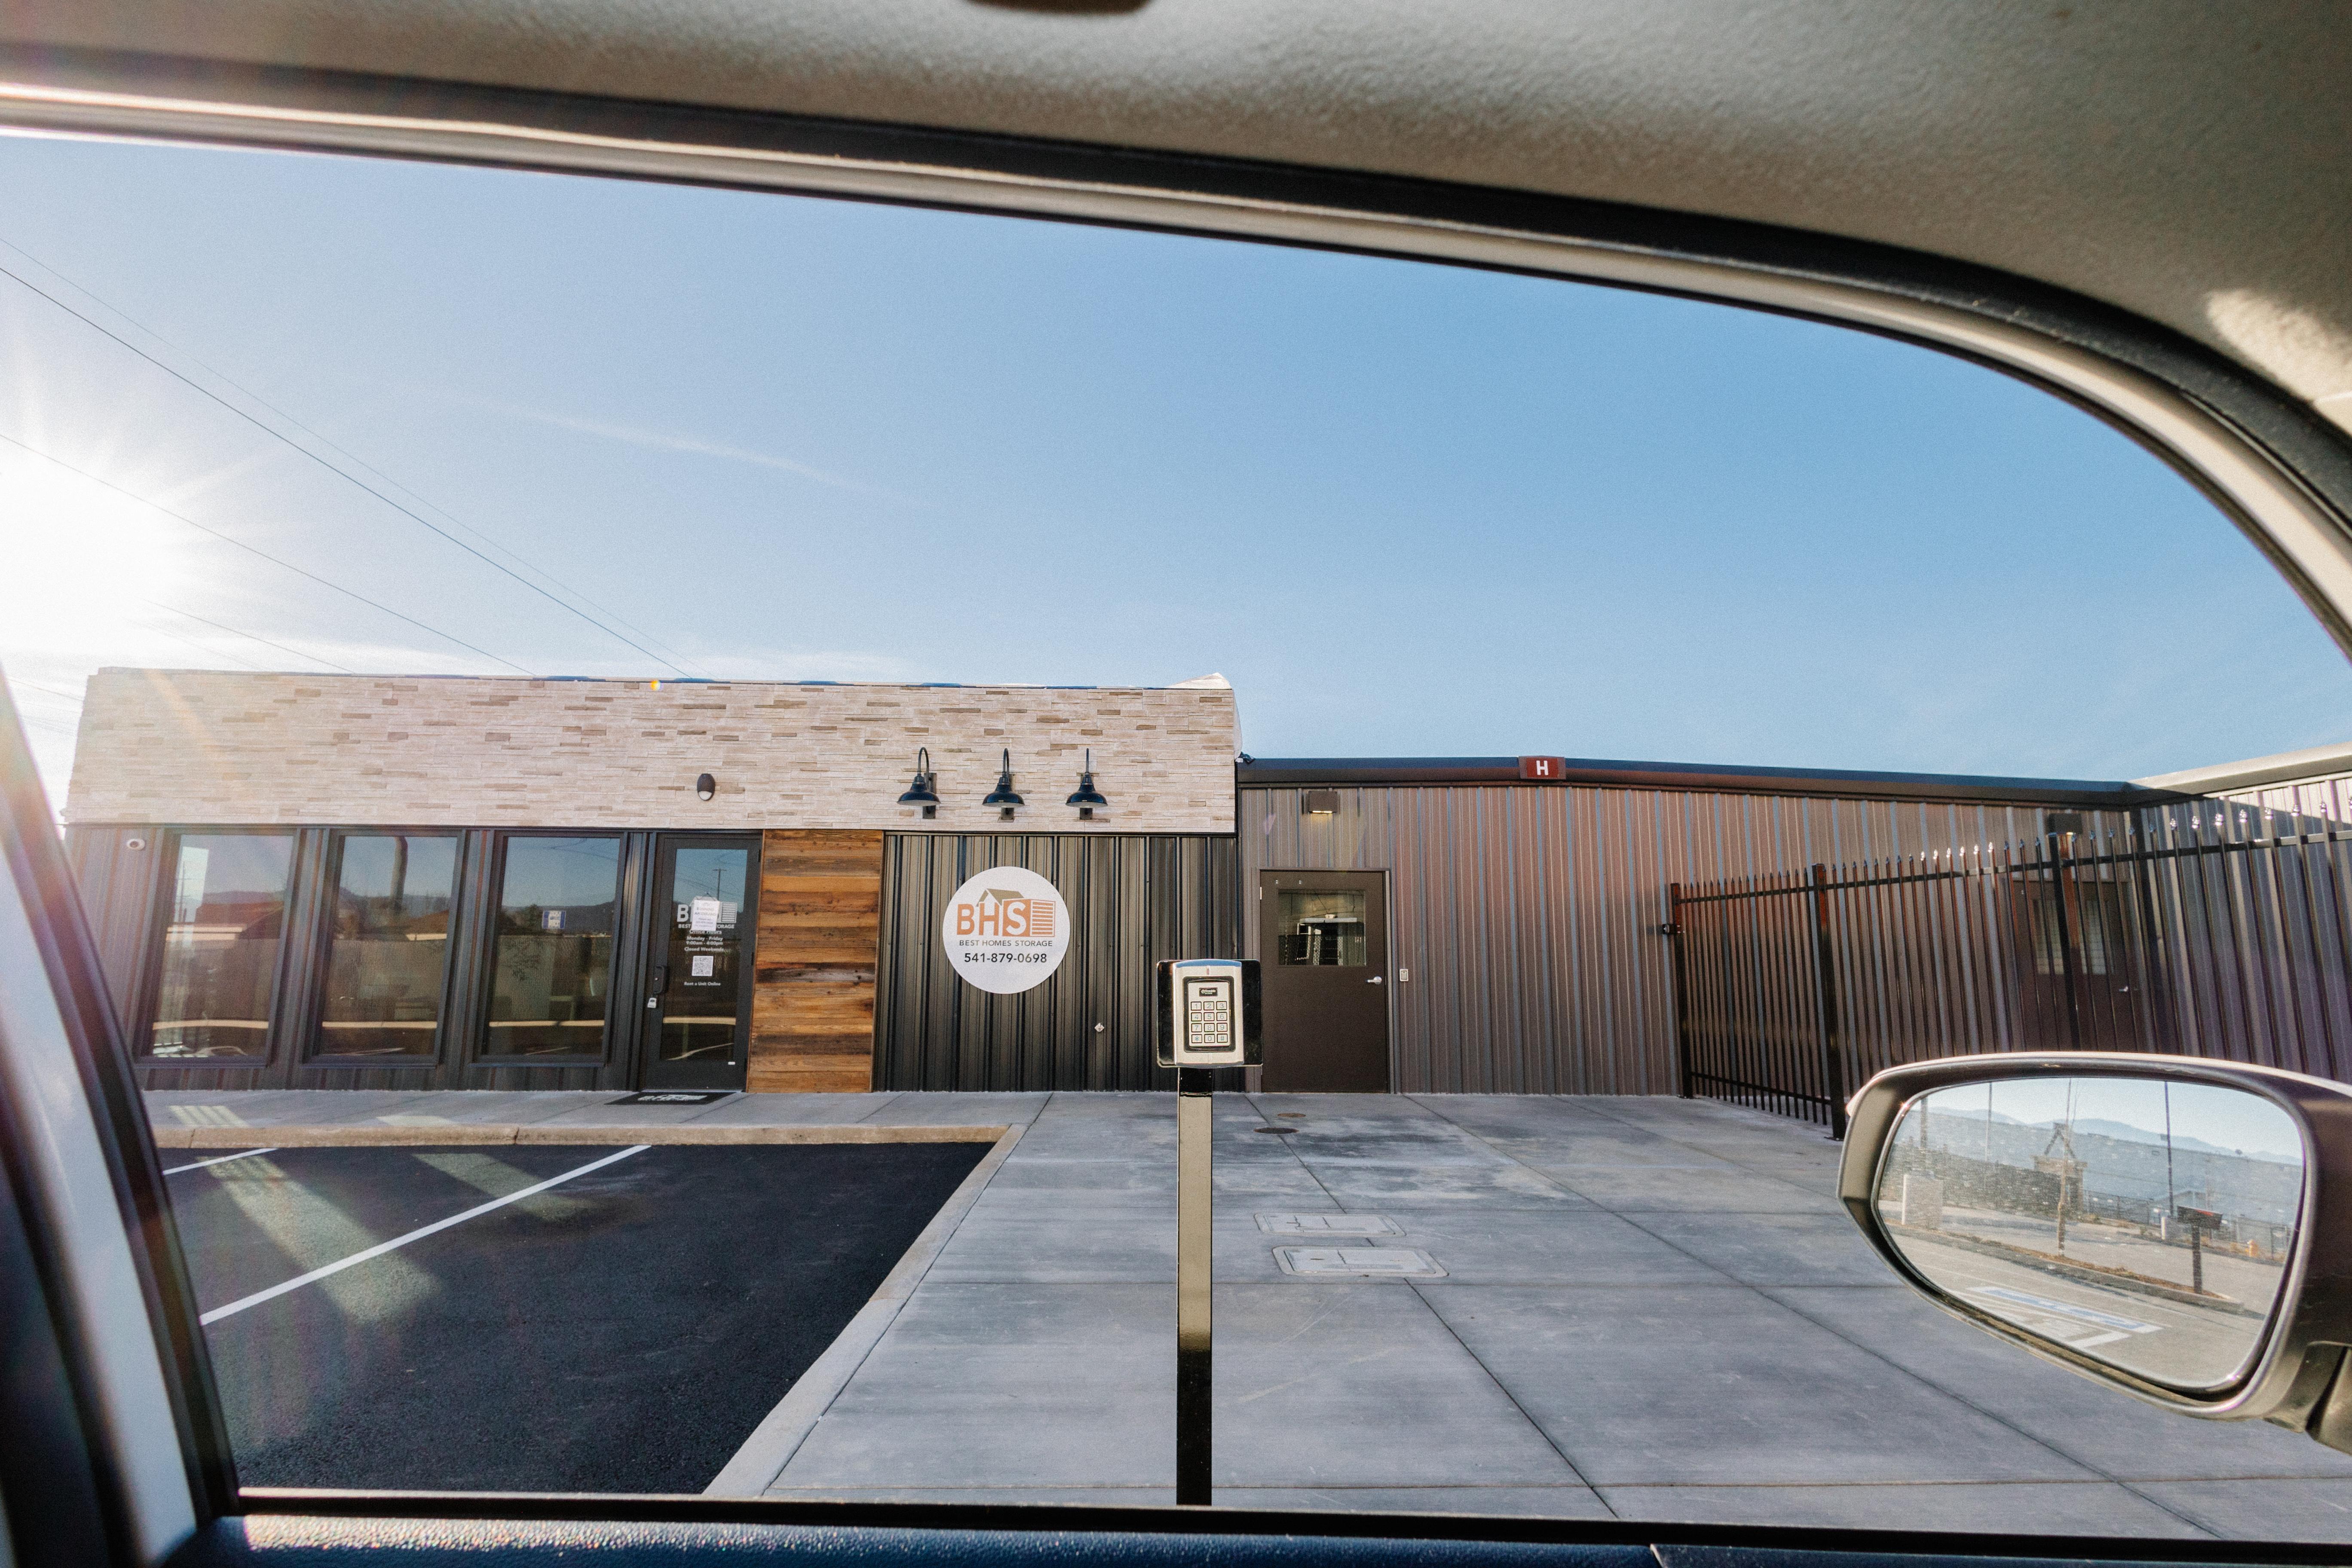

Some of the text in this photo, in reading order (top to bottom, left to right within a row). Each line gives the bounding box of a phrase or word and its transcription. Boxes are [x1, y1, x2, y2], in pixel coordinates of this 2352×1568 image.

[1536, 760, 1549, 775] H
[957, 901, 1027, 936] BHS
[964, 953, 1047, 963] 541-879-0698
